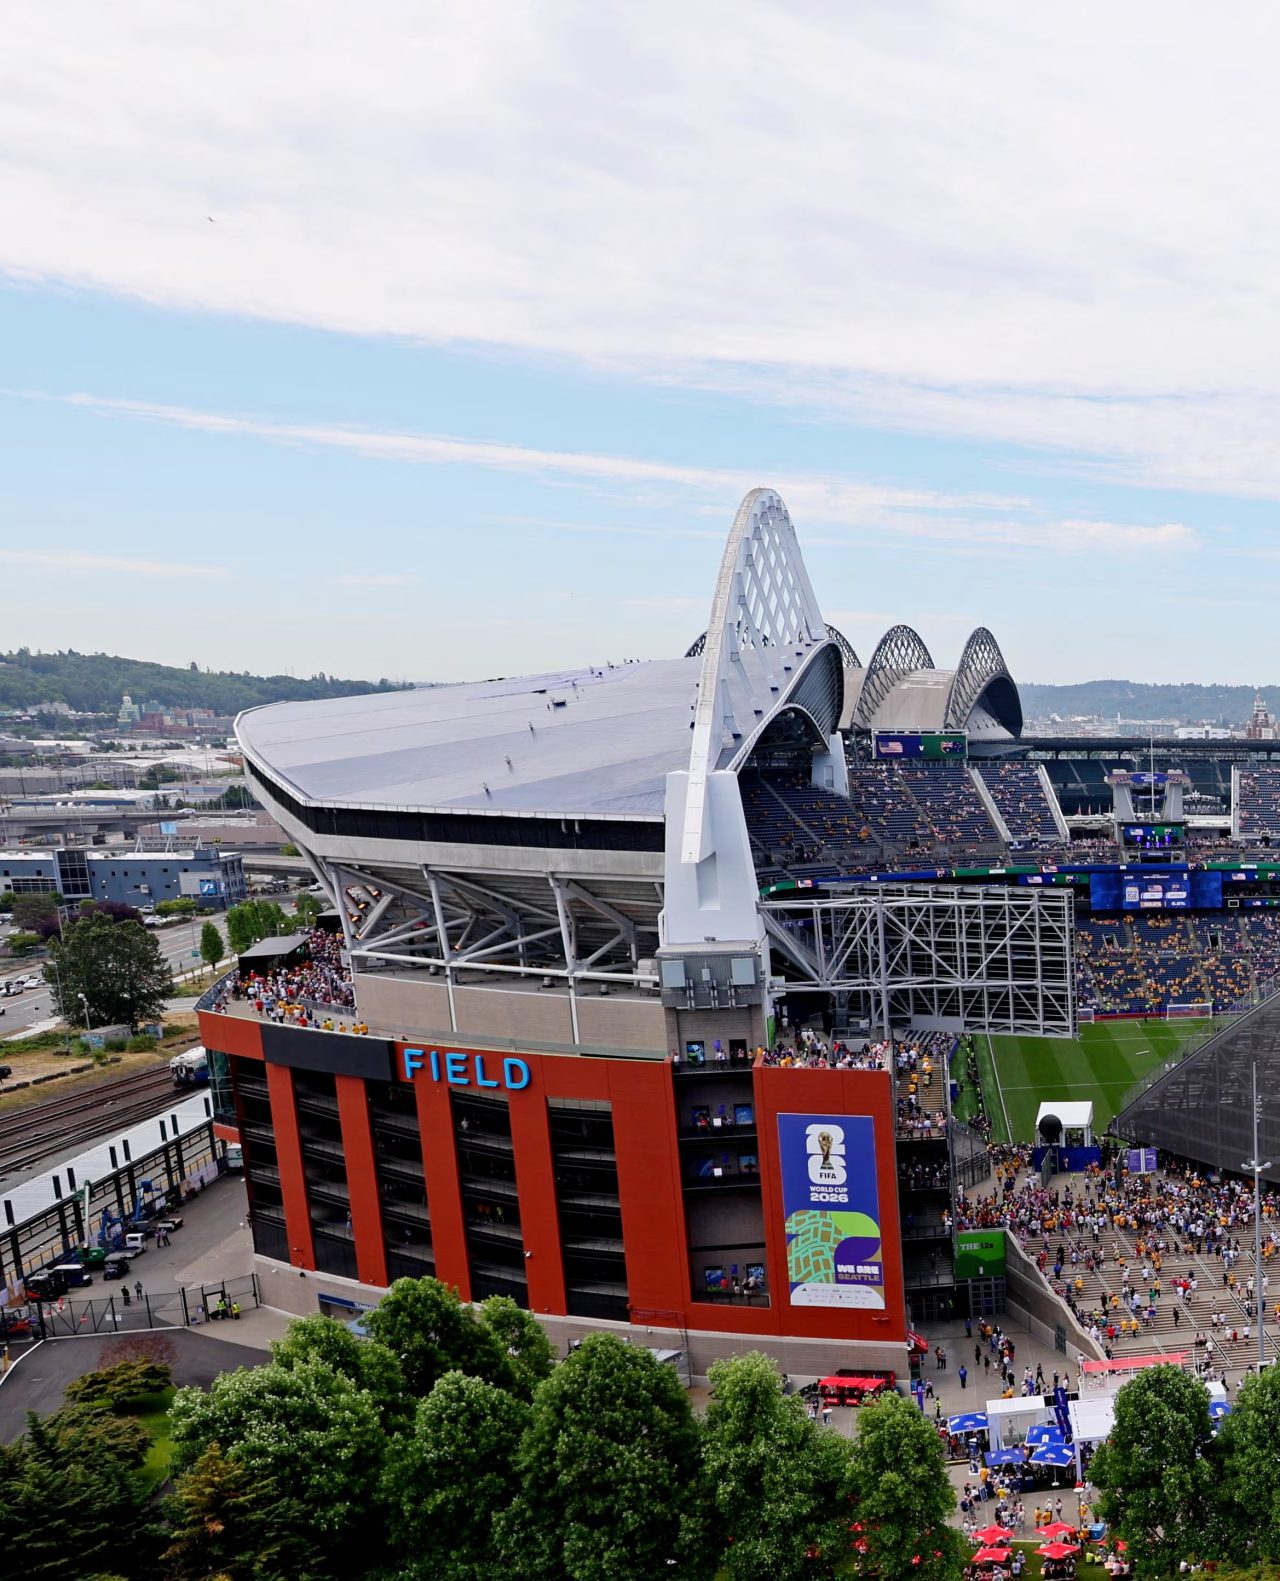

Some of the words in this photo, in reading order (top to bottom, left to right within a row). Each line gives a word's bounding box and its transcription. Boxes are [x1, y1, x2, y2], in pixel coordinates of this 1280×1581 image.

[403, 1048, 531, 1090] FIELD
[819, 1172, 837, 1180] FIFA
[809, 1185, 834, 1194] WORLD
[834, 1186, 848, 1194] CUP
[810, 1193, 849, 1203] 2026
[960, 1242, 980, 1251] THE
[837, 1264, 856, 1273] WE
[838, 1273, 880, 1283] SEATTLE
